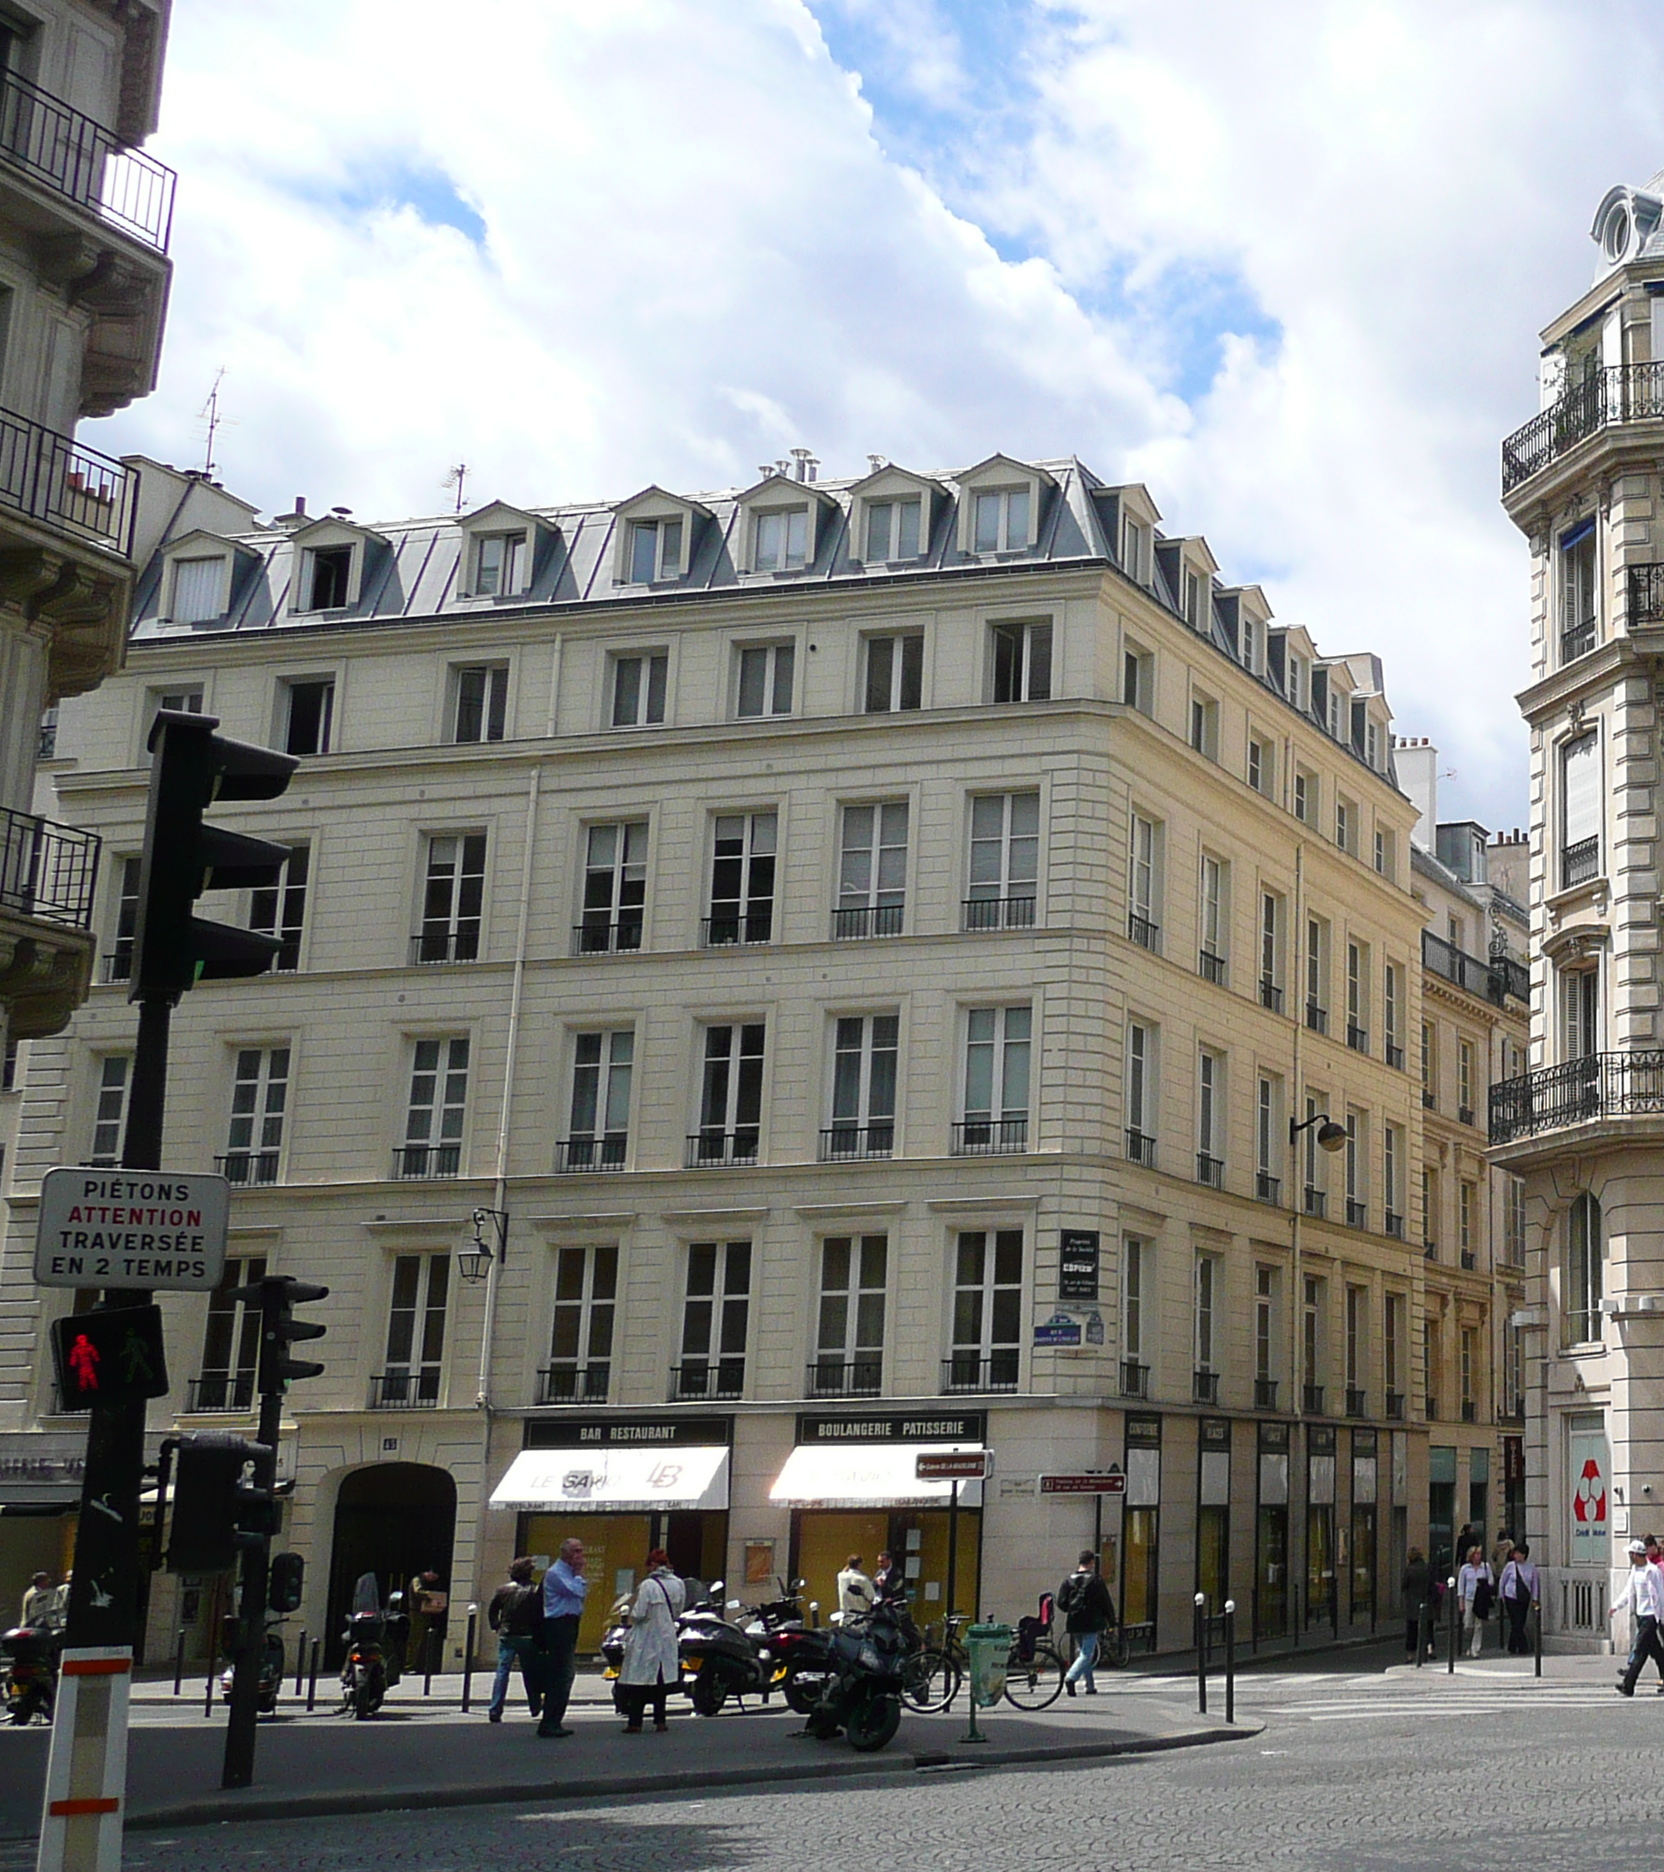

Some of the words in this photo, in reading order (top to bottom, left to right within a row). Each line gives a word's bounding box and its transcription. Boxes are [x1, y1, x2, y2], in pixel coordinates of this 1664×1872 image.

[83, 1179, 190, 1201] PIÉTONS
[68, 1206, 202, 1227] ATTENTION
[60, 1231, 205, 1252] TRAVERSÉE
[51, 1257, 84, 1274] EN
[95, 1258, 110, 1275] 2
[123, 1259, 205, 1278] TEMPS
[580, 1427, 602, 1440] BAR
[610, 1426, 677, 1439] RESTAURANT
[818, 1423, 893, 1437] BOULANGERIE
[902, 1421, 965, 1435] PATISSERIE
